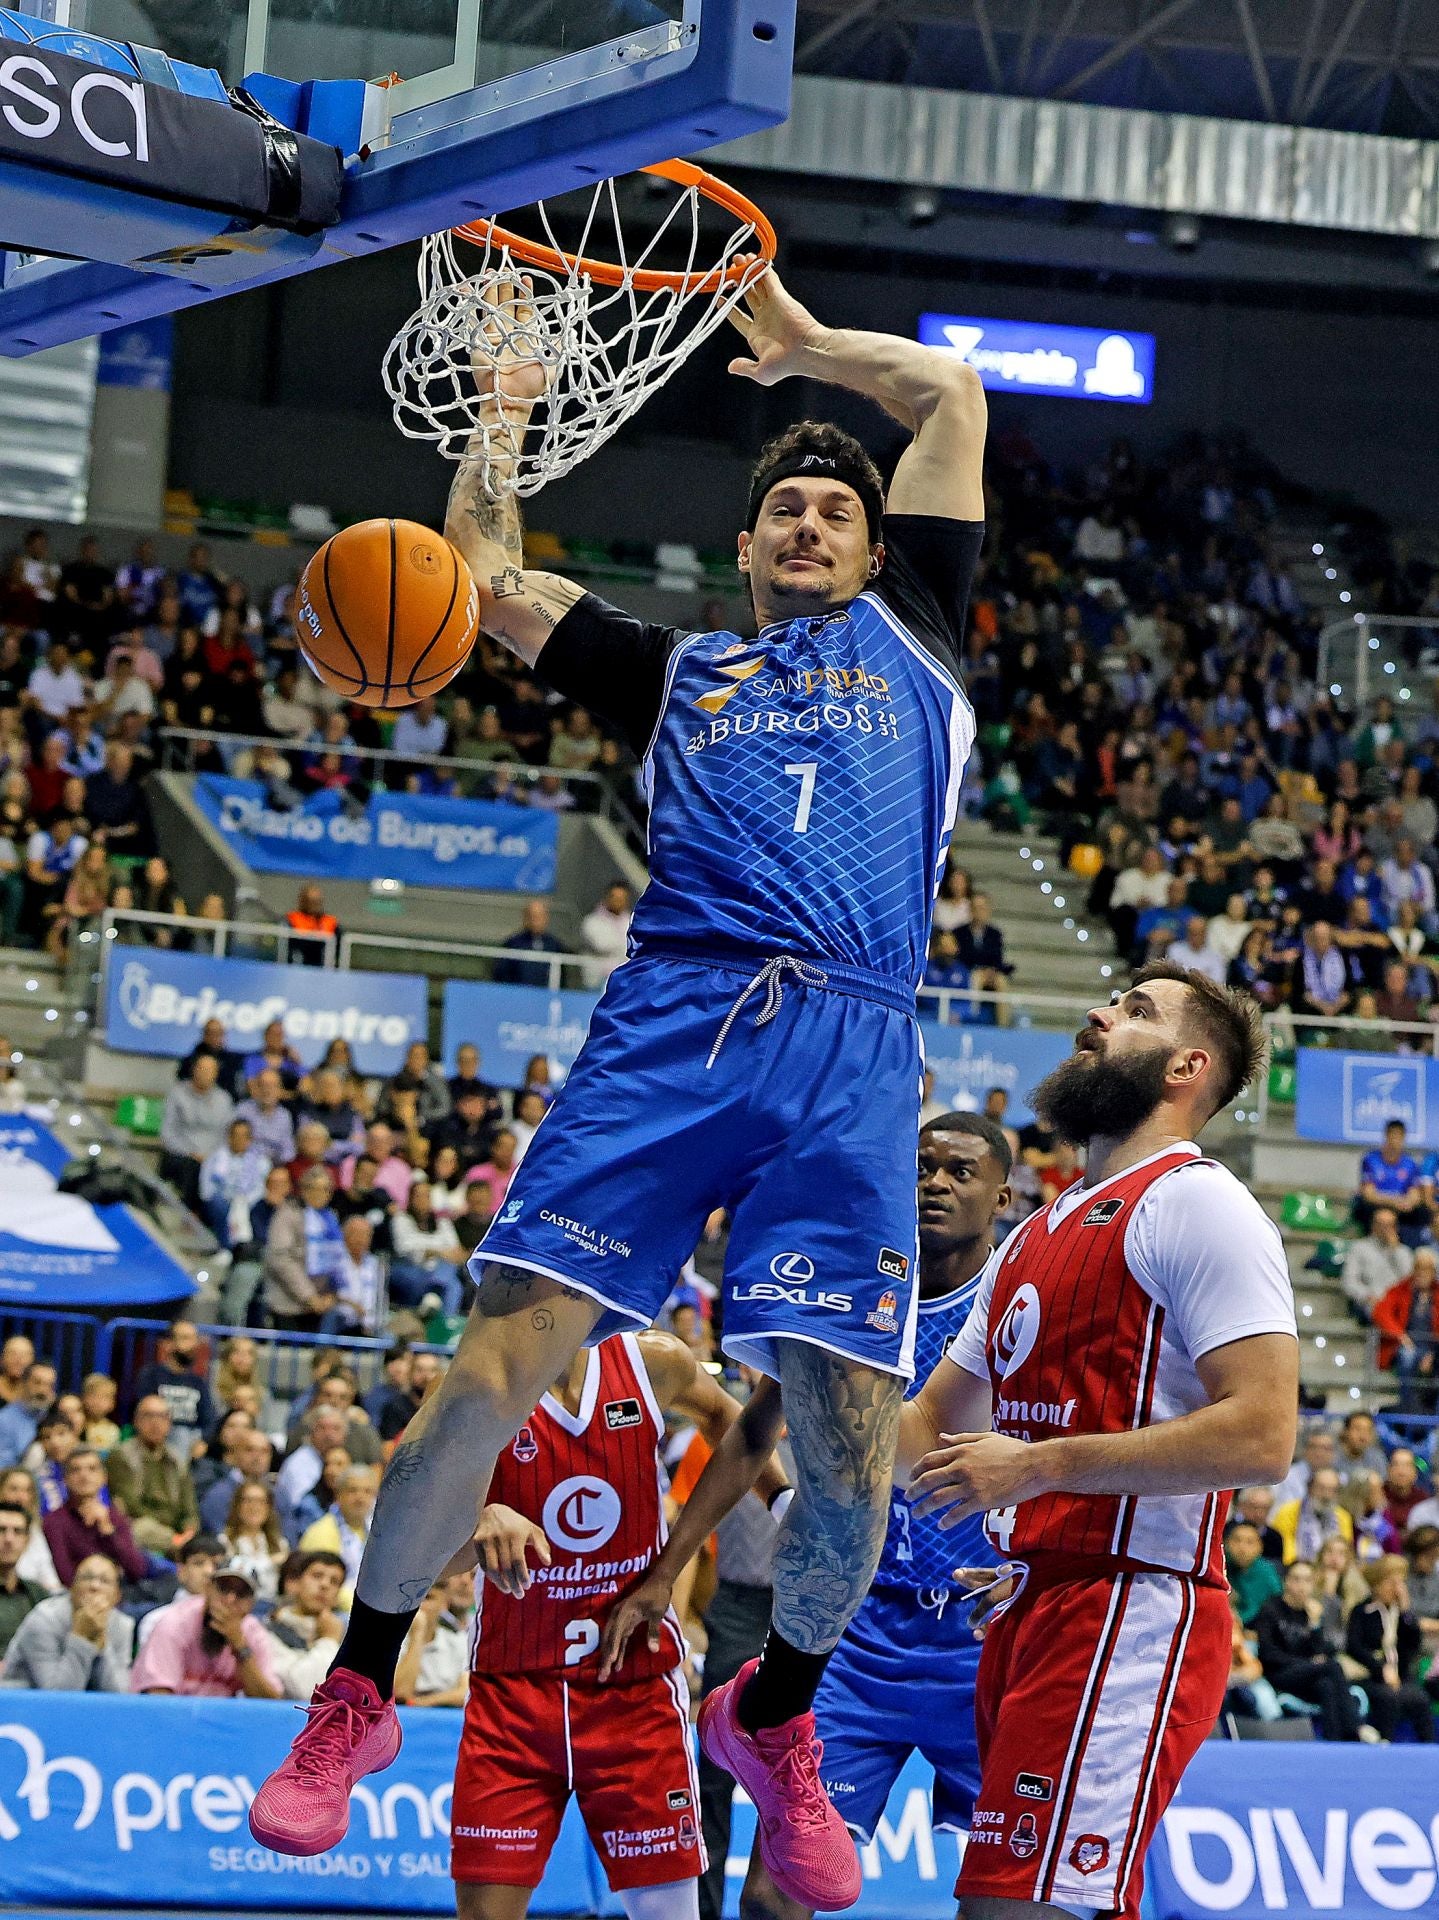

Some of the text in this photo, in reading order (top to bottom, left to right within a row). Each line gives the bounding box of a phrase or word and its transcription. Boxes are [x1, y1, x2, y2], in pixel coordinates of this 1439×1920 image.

[709, 703, 873, 746] BURGOS
[784, 762, 818, 833] 7
[539, 1209, 596, 1241] CASTILLA
[732, 1283, 853, 1312] LEXUS
[982, 1504, 1017, 1552] 4
[1018, 1783, 1043, 1796] acb
[454, 1825, 538, 1839] azulmarino
[617, 1826, 675, 1843] Zaragoza
[398, 1853, 452, 1878] SAL
[1163, 1805, 1439, 1912] DIVe
